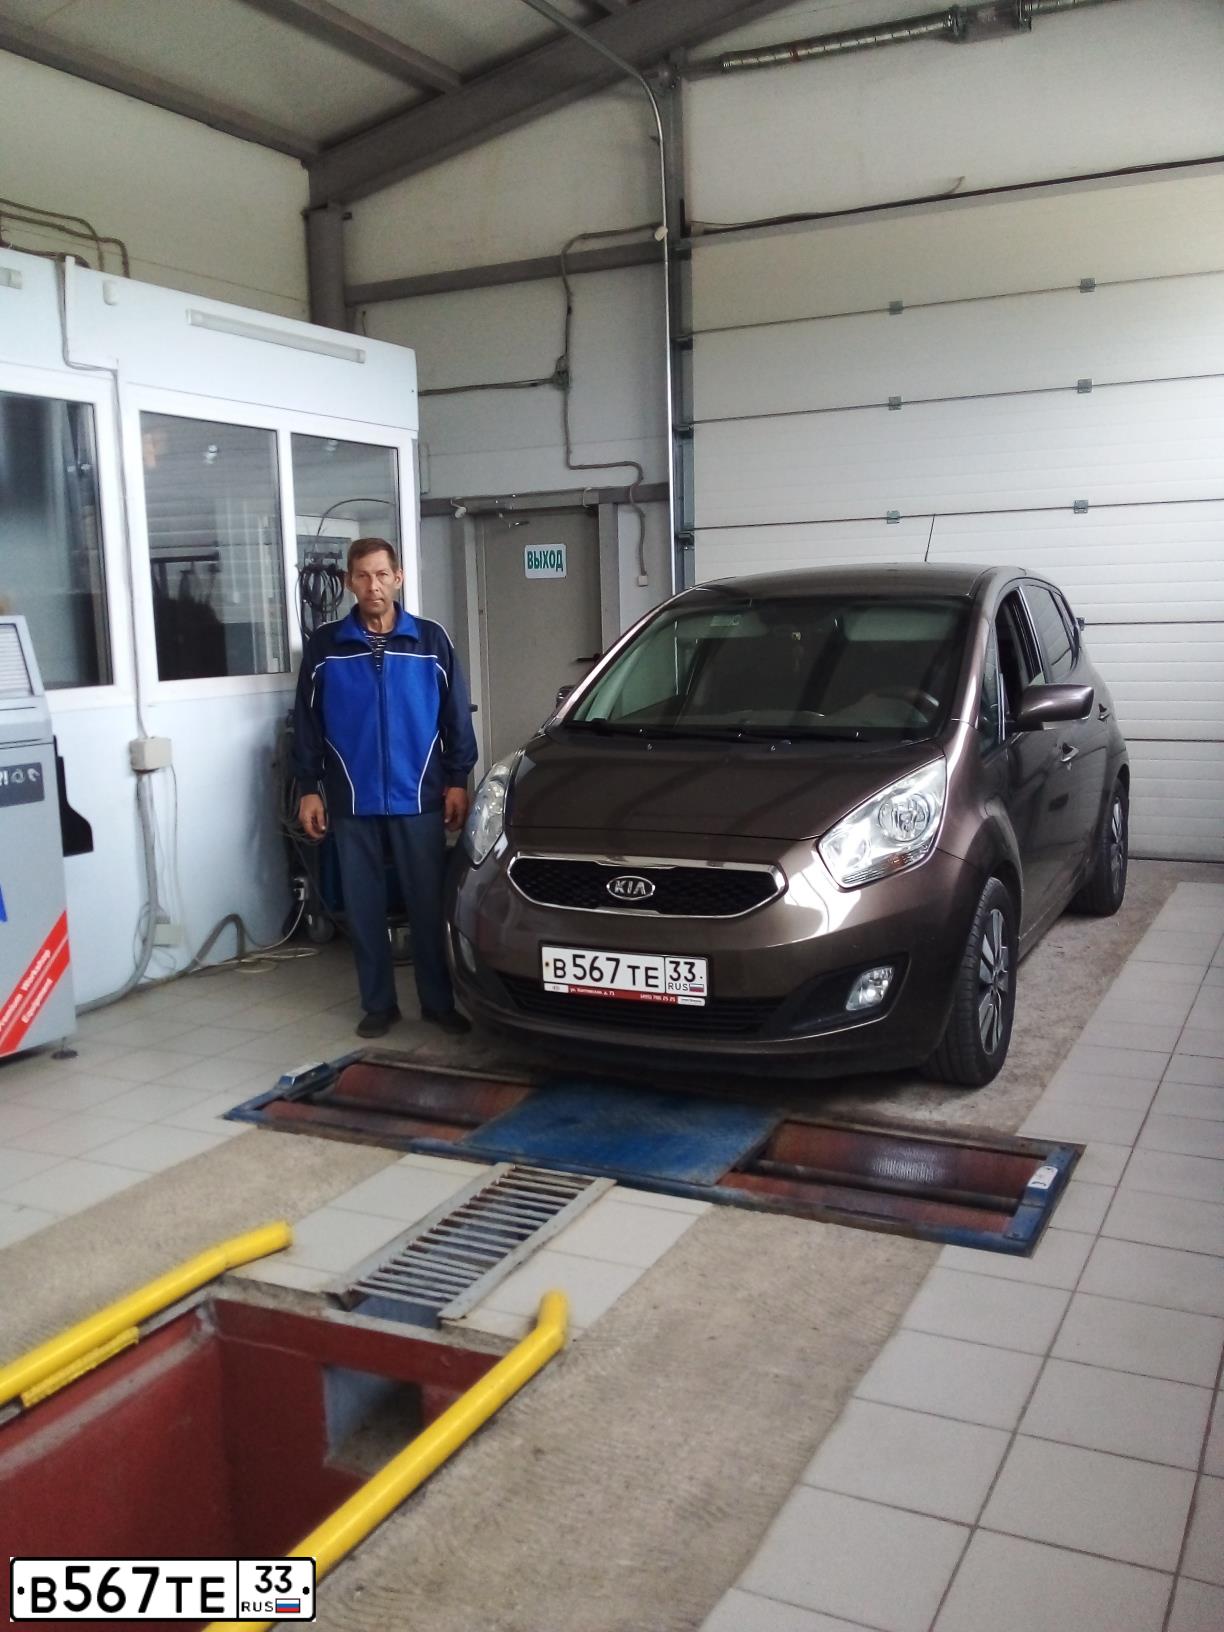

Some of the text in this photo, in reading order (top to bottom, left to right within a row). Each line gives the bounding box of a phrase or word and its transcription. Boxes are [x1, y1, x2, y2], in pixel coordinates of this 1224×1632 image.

[527, 549, 564, 572] ВЫХОД
[614, 880, 646, 895] KIA
[668, 960, 696, 983] 33
[668, 982, 689, 992] RUS
